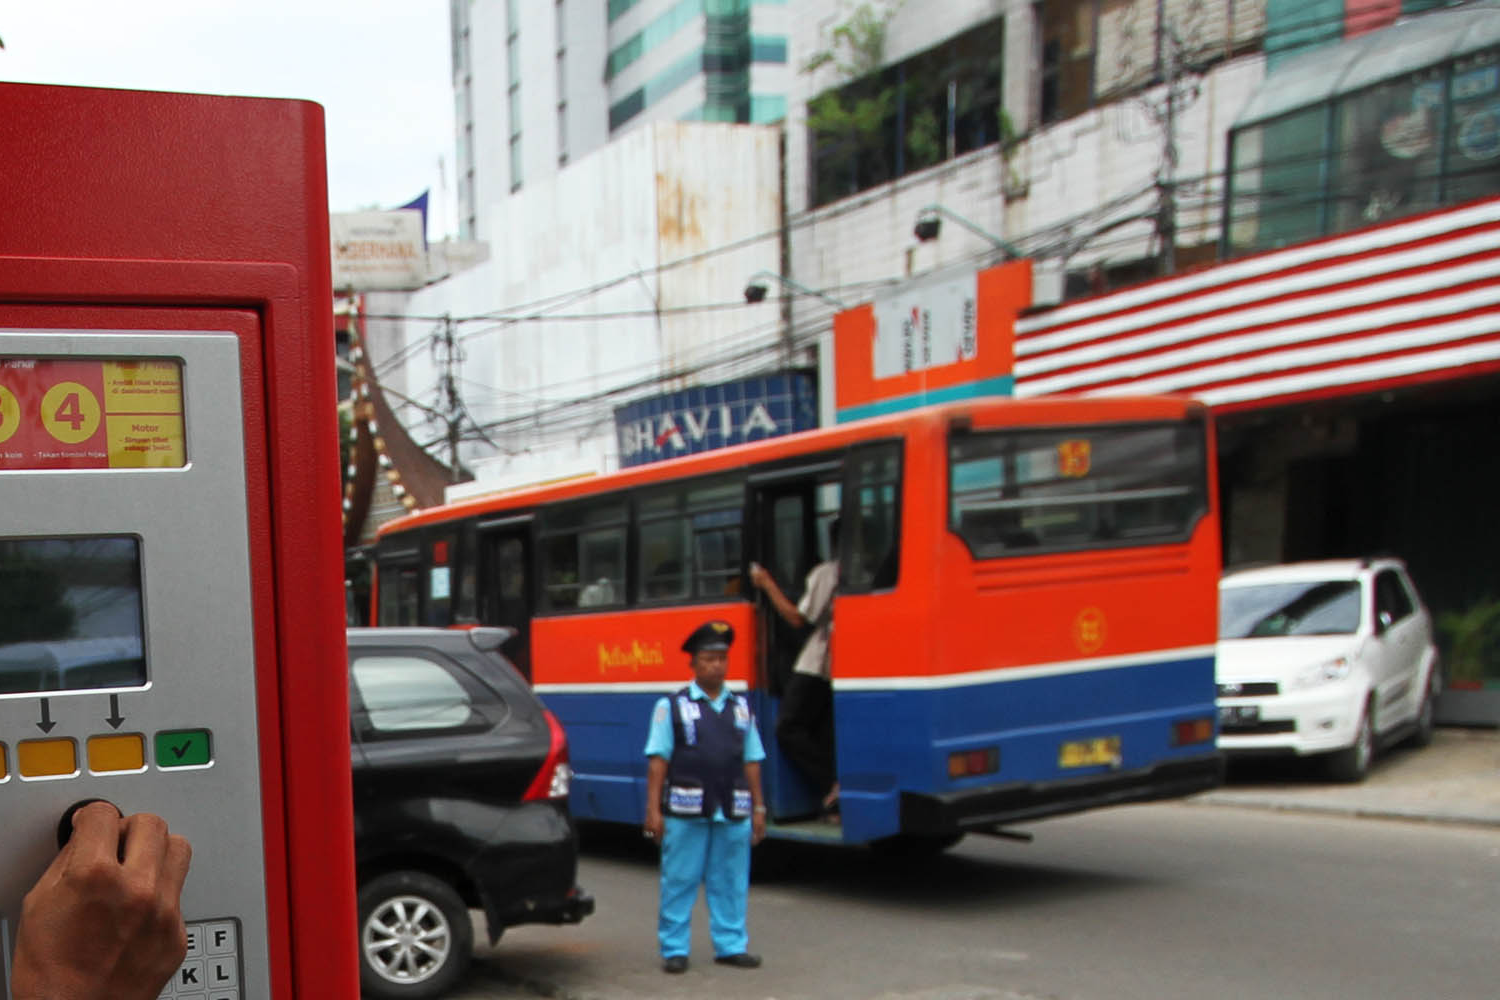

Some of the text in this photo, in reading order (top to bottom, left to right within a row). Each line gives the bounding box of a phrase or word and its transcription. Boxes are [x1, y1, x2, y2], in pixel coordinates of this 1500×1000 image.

[53, 392, 85, 431] 4
[132, 424, 159, 433] Motor
[214, 931, 227, 948] F
[182, 964, 229, 985] K L
